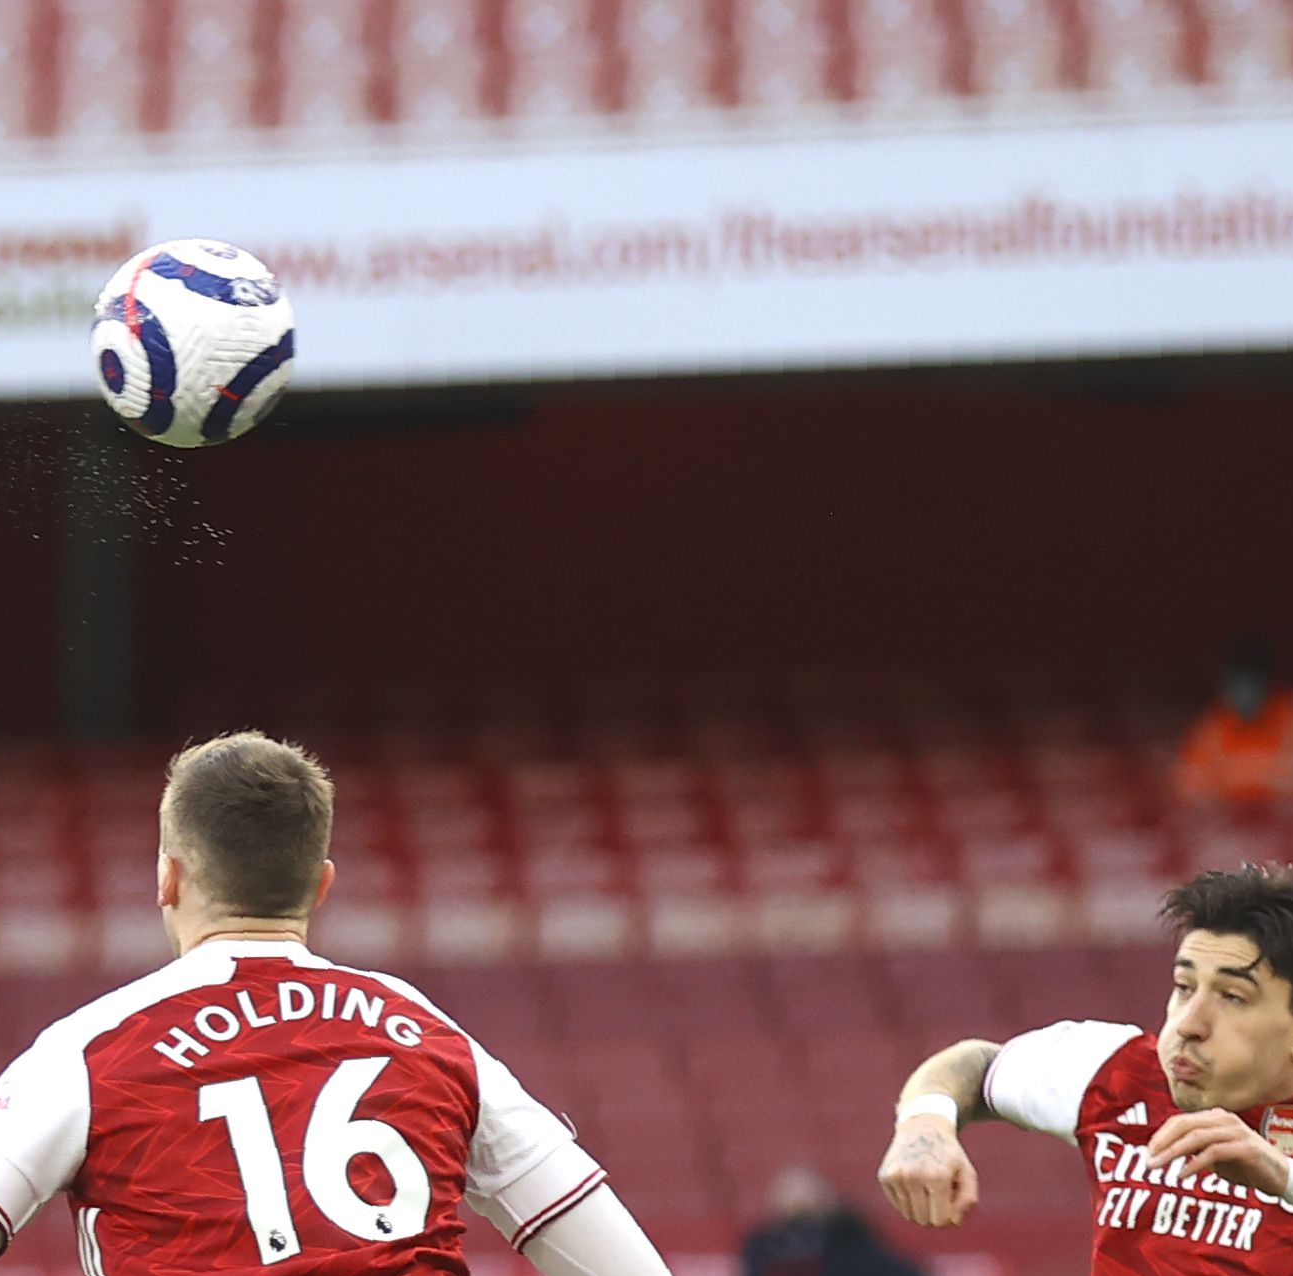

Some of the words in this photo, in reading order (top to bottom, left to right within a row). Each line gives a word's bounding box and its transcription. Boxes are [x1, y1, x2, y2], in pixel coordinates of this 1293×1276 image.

[152, 981, 423, 1069] HOLDING
[197, 1055, 433, 1267] 16
[1097, 1186, 1151, 1230] FLY
[1151, 1192, 1263, 1251] BETTER
